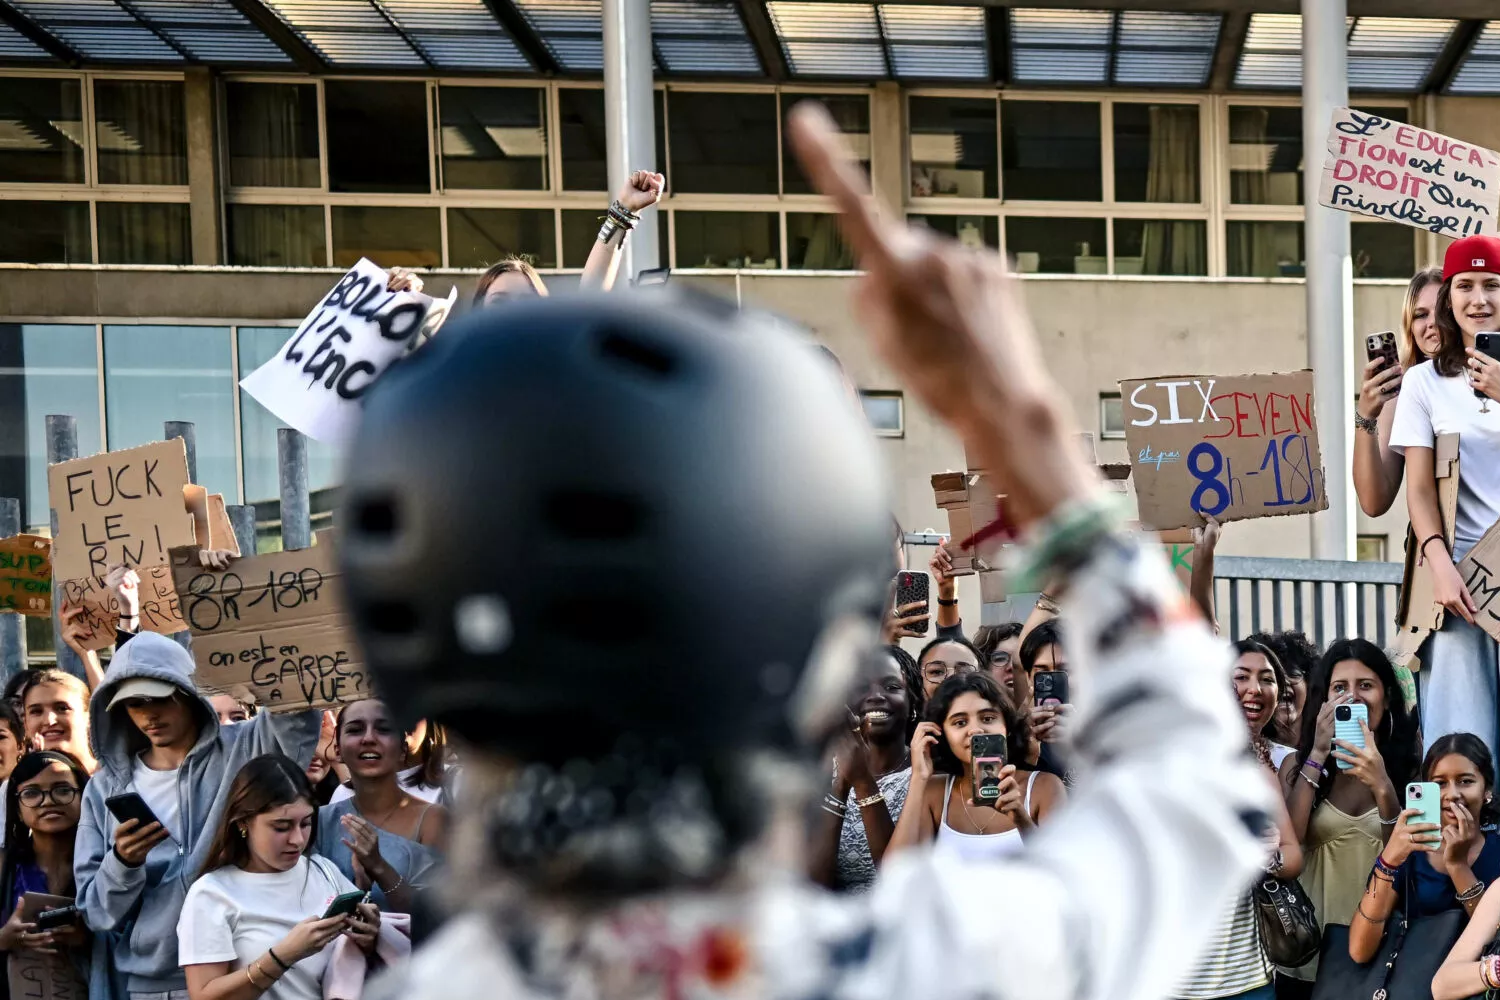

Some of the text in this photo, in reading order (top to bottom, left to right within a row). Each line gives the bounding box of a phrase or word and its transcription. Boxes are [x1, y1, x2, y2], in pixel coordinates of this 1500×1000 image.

[1408, 156, 1445, 177] est
[1453, 170, 1486, 190] un
[1130, 380, 1313, 438] SIX SEVEN
[66, 459, 162, 512] FUCK
[82, 514, 130, 547] LE
[209, 635, 299, 667] on est en
[251, 651, 351, 686] GARDE
